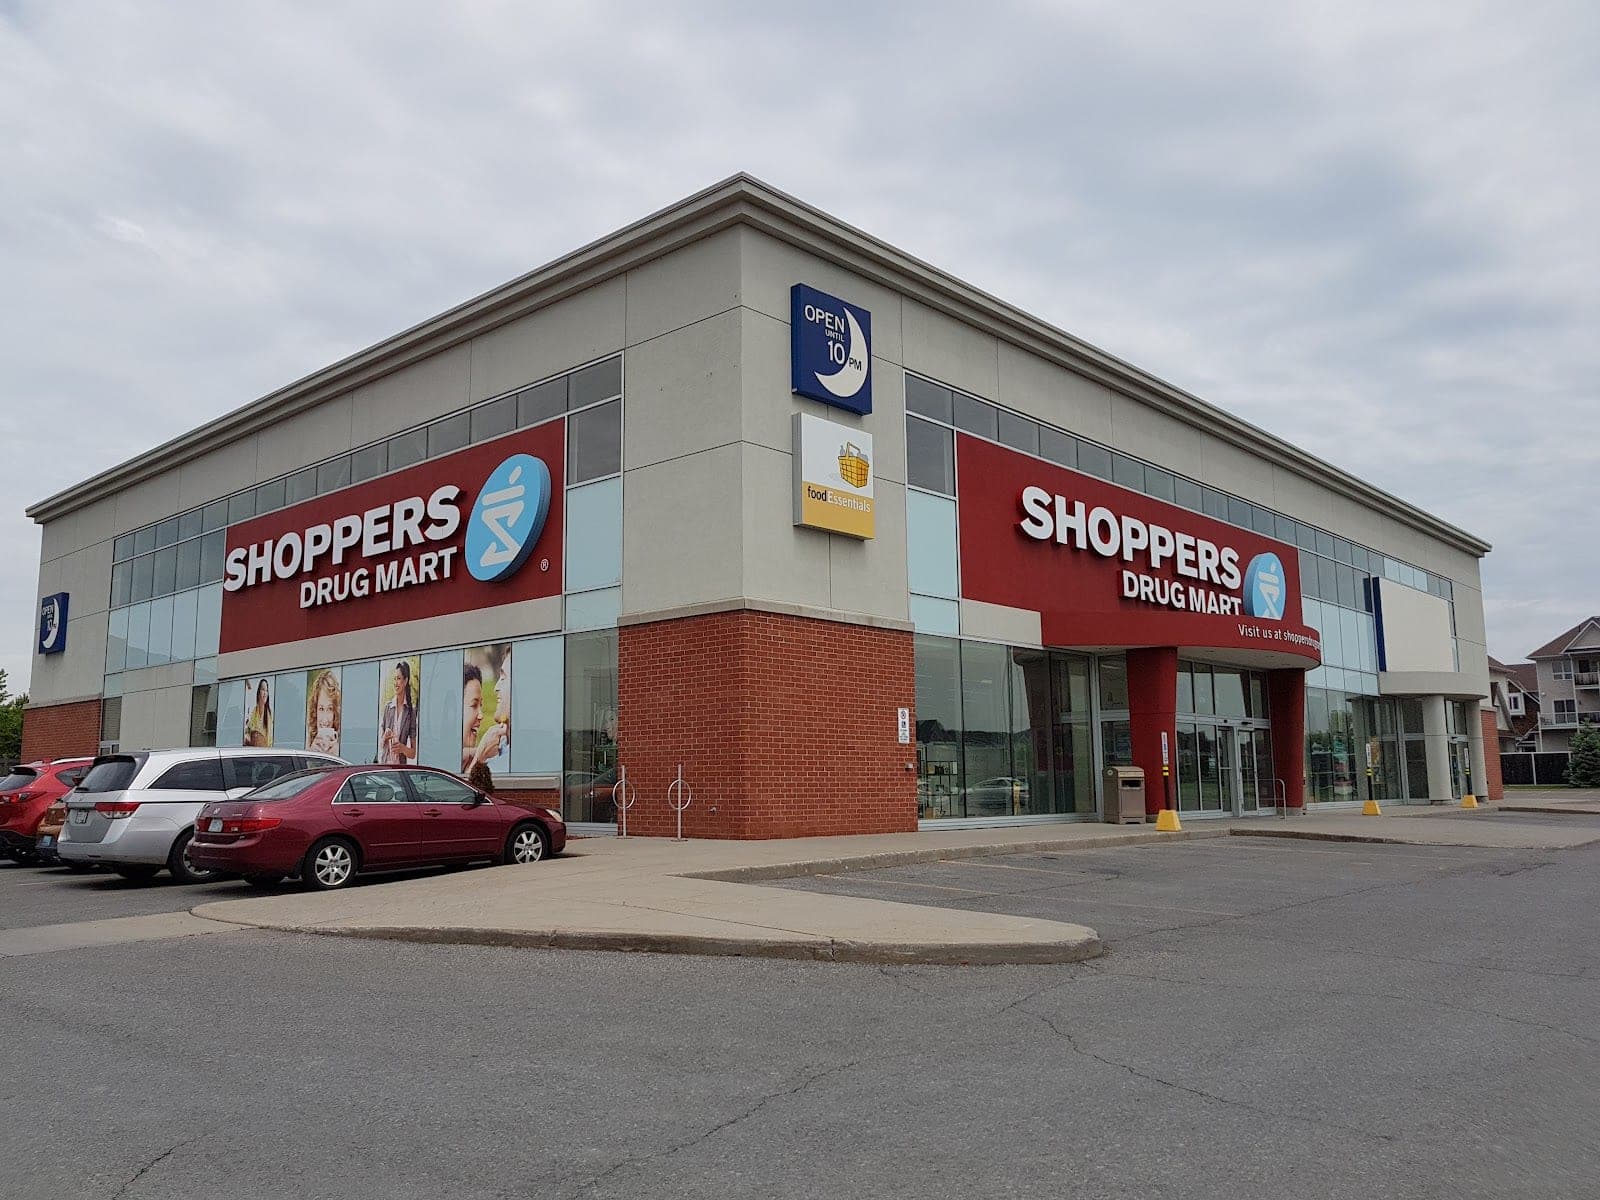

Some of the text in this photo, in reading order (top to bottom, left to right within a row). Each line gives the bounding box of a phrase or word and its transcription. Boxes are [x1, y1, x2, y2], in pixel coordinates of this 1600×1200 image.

[804, 304, 845, 333] OPEN
[825, 329, 845, 342] UNTIL
[827, 341, 862, 371] 10 PM
[223, 485, 461, 592] SHOPPERS
[1020, 486, 1242, 590] SHOPPERS
[299, 546, 458, 609] DRUG MART
[1122, 569, 1242, 616] DRUG MART
[1237, 623, 1260, 638] Visit
[1262, 629, 1273, 639] us
[1274, 628, 1282, 640] at
